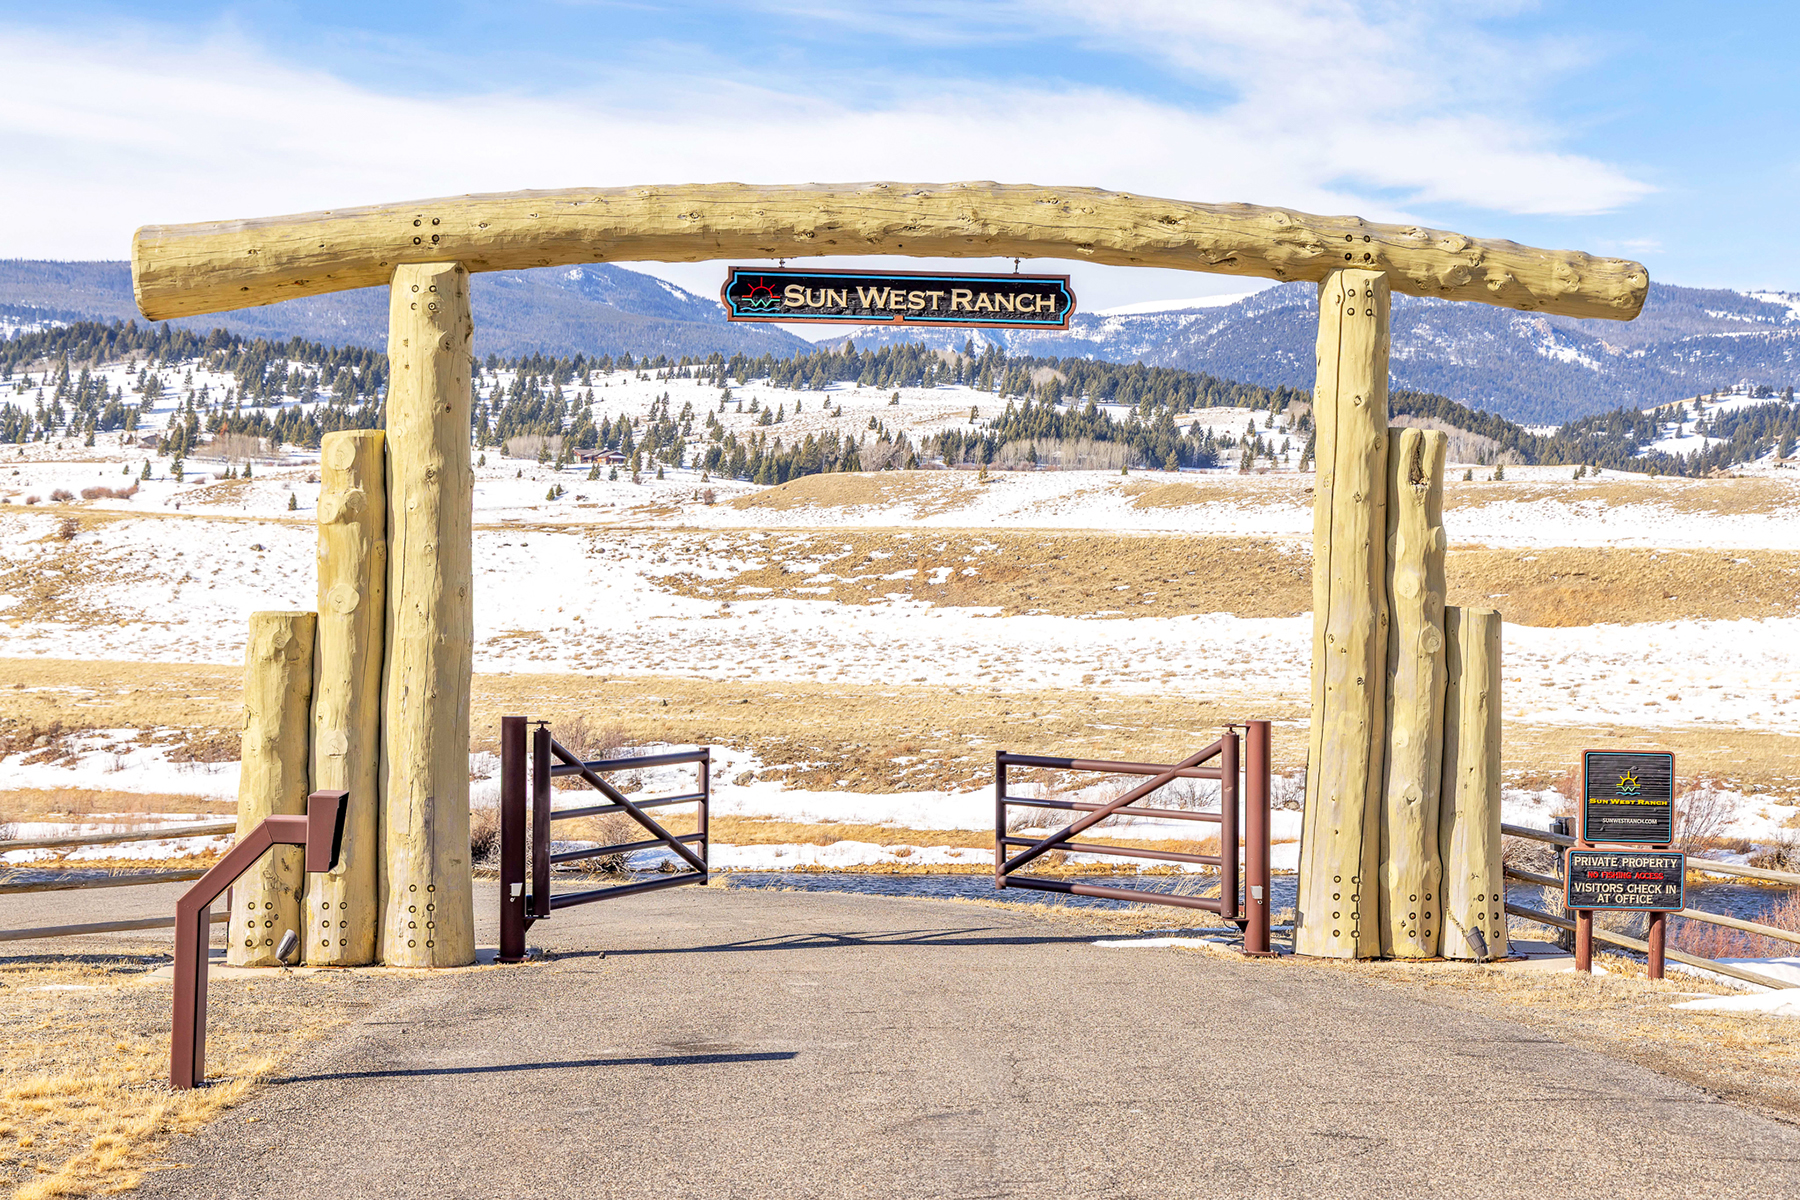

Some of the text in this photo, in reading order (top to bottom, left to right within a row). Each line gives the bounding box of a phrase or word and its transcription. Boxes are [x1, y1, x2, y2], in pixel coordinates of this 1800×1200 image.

[784, 284, 1056, 313] SUN WEST RANCH
[1574, 856, 1677, 868] PRIVATE PROPERTY
[1587, 871, 1664, 880] NO FISHING ACCESS
[1574, 882, 1677, 894] VISITORS CHECK IN
[1597, 894, 1653, 904] AT OFFICE
